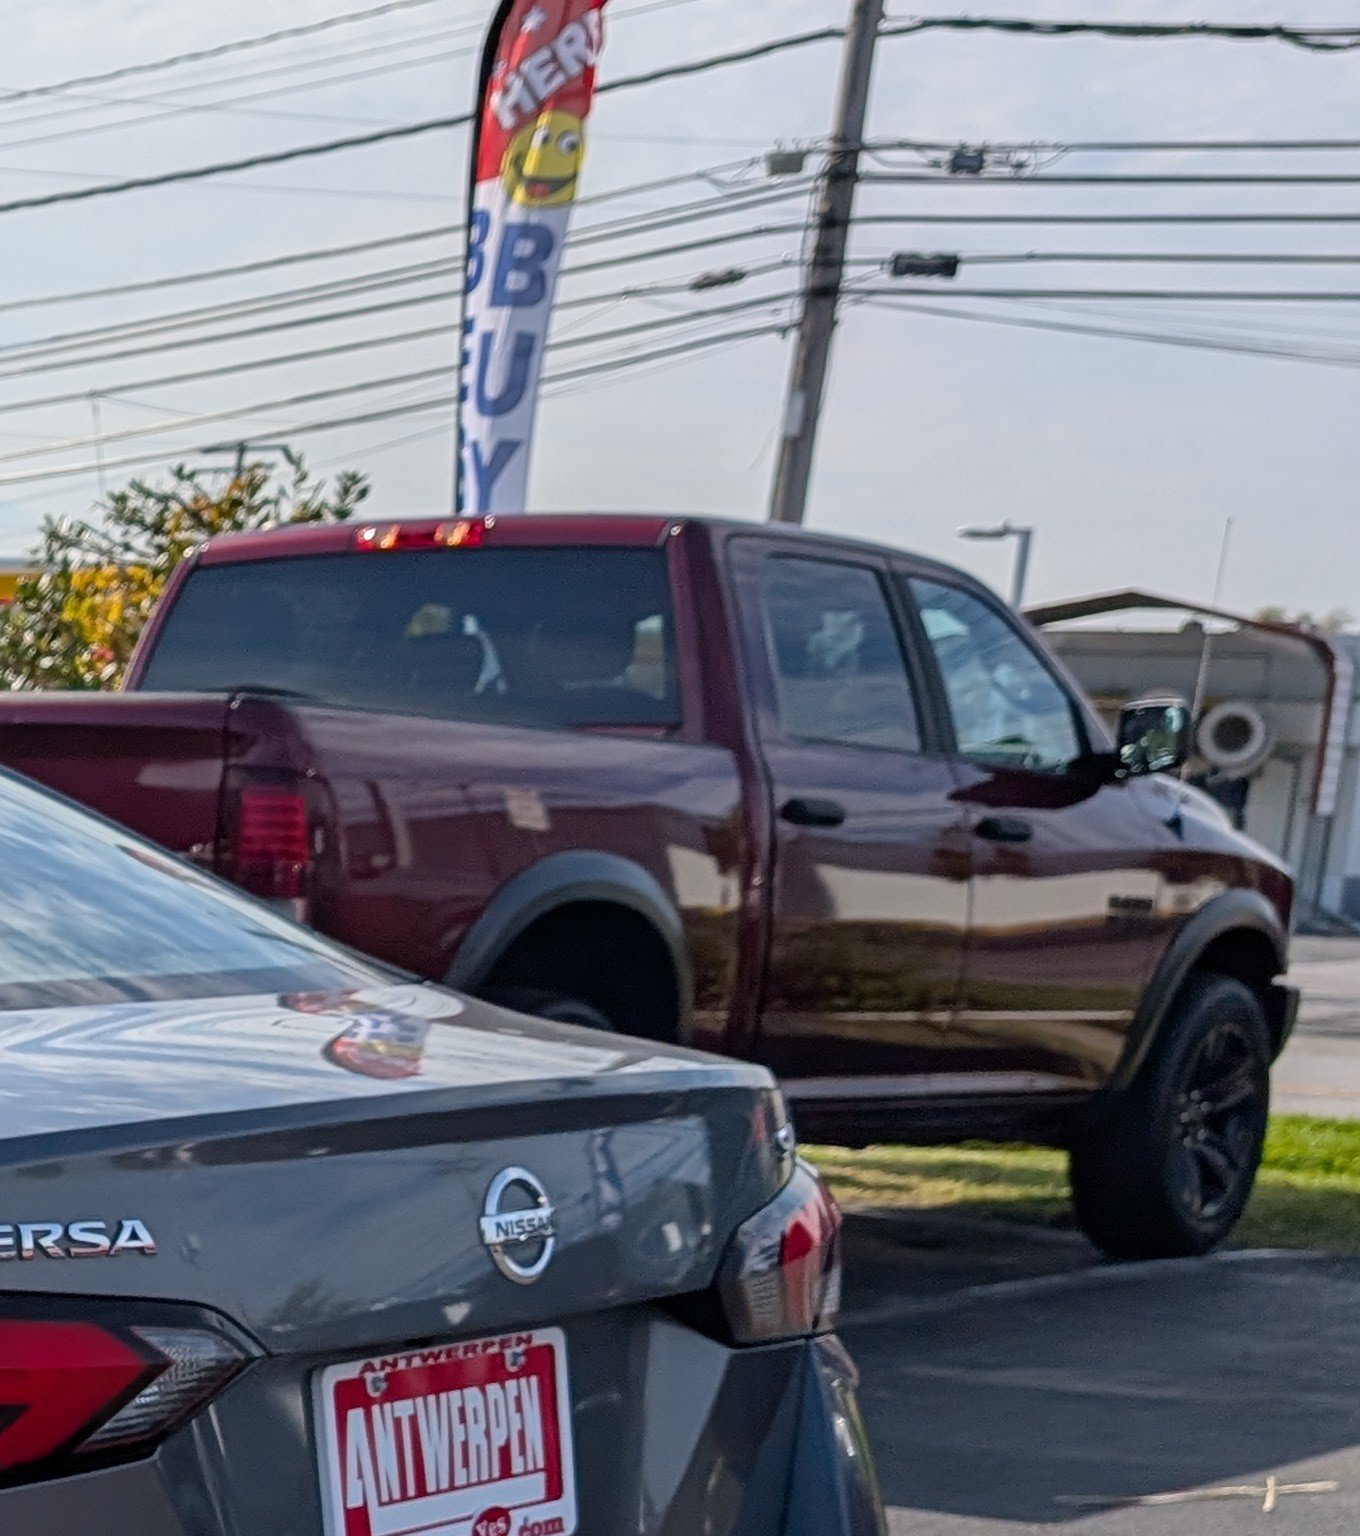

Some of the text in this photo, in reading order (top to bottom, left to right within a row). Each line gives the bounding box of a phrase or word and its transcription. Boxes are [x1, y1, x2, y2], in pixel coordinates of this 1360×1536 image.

[462, 221, 556, 514] BUY
[359, 1333, 533, 1375] ANTWERPEN
[345, 1375, 545, 1510] ANTWERPEN
